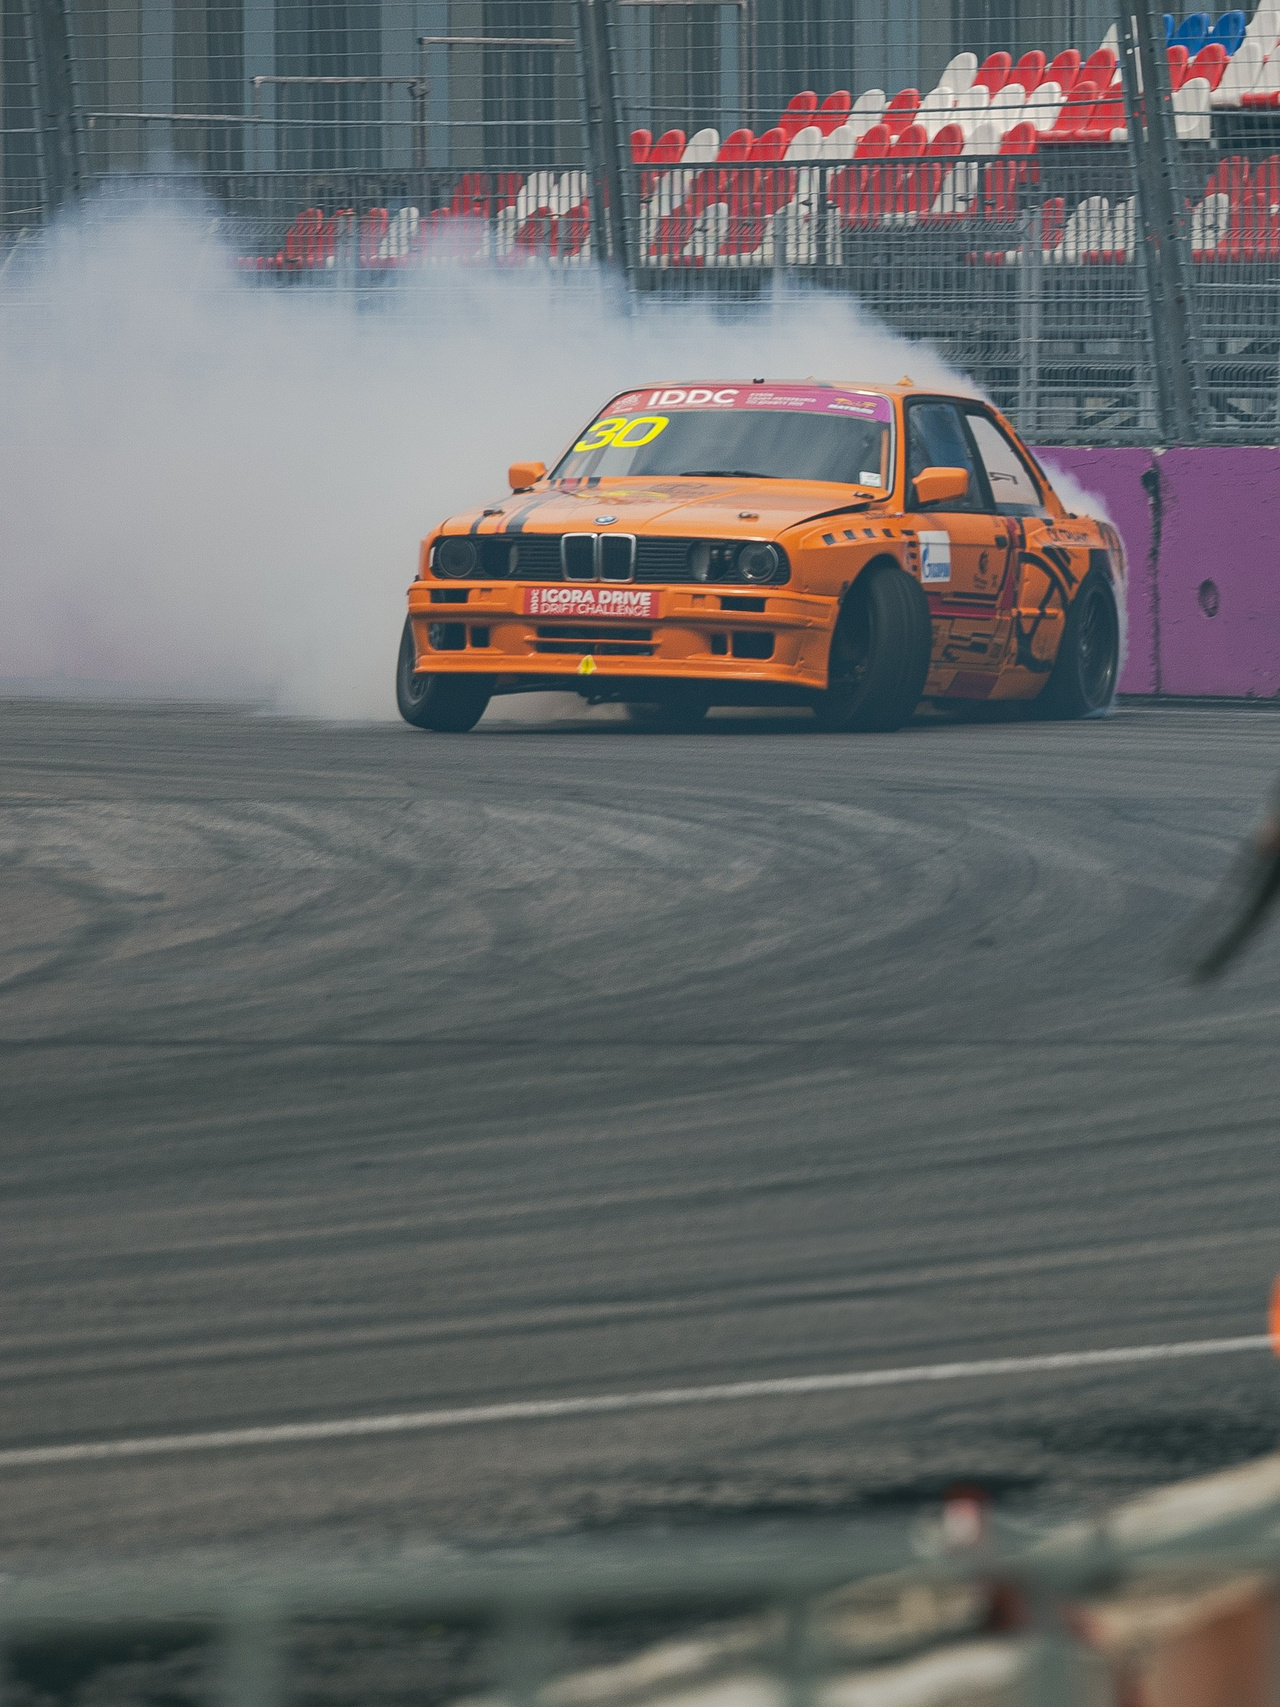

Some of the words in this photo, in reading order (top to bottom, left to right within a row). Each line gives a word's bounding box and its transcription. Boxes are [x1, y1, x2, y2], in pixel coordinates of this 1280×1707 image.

[648, 388, 740, 407] IDDC
[573, 416, 670, 452] 30
[541, 589, 595, 603] IGORA
[599, 591, 651, 605] DRIVE
[540, 603, 576, 613] DRIFT
[577, 603, 651, 616] CHALLENGE
